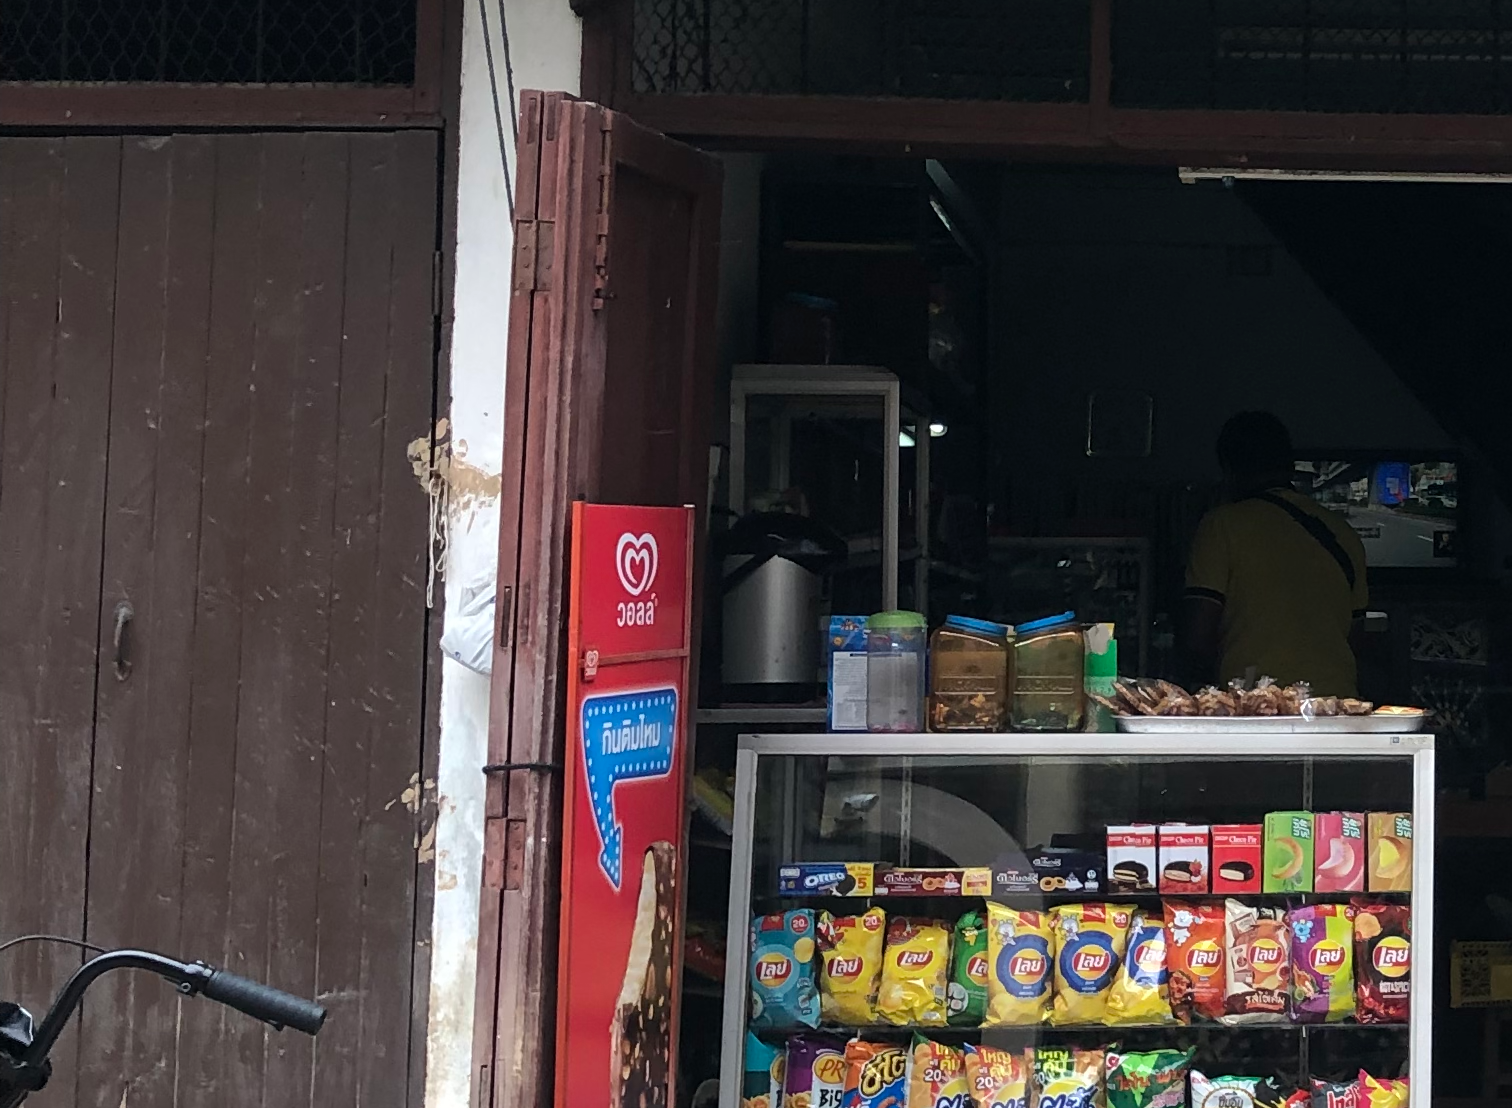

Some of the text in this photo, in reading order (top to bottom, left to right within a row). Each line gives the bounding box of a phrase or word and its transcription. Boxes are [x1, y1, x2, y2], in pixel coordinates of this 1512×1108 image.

[617, 592, 657, 628] วอลล์
[601, 713, 662, 757] กินติมไหม
[803, 871, 846, 889] OREO
[857, 876, 867, 890] 5
[792, 918, 806, 929] 20
[865, 916, 879, 926] 20
[900, 950, 931, 967] เลย์
[1076, 950, 1108, 972] เลย์
[1191, 947, 1220, 968] เลย์
[1253, 946, 1279, 964] เลย์
[1314, 945, 1342, 967] เลย์
[1378, 944, 1410, 967] เลย์
[760, 959, 788, 980] เลย์
[831, 957, 860, 977] เลย์
[970, 958, 988, 976] เล
[1014, 954, 1046, 977] เลย์
